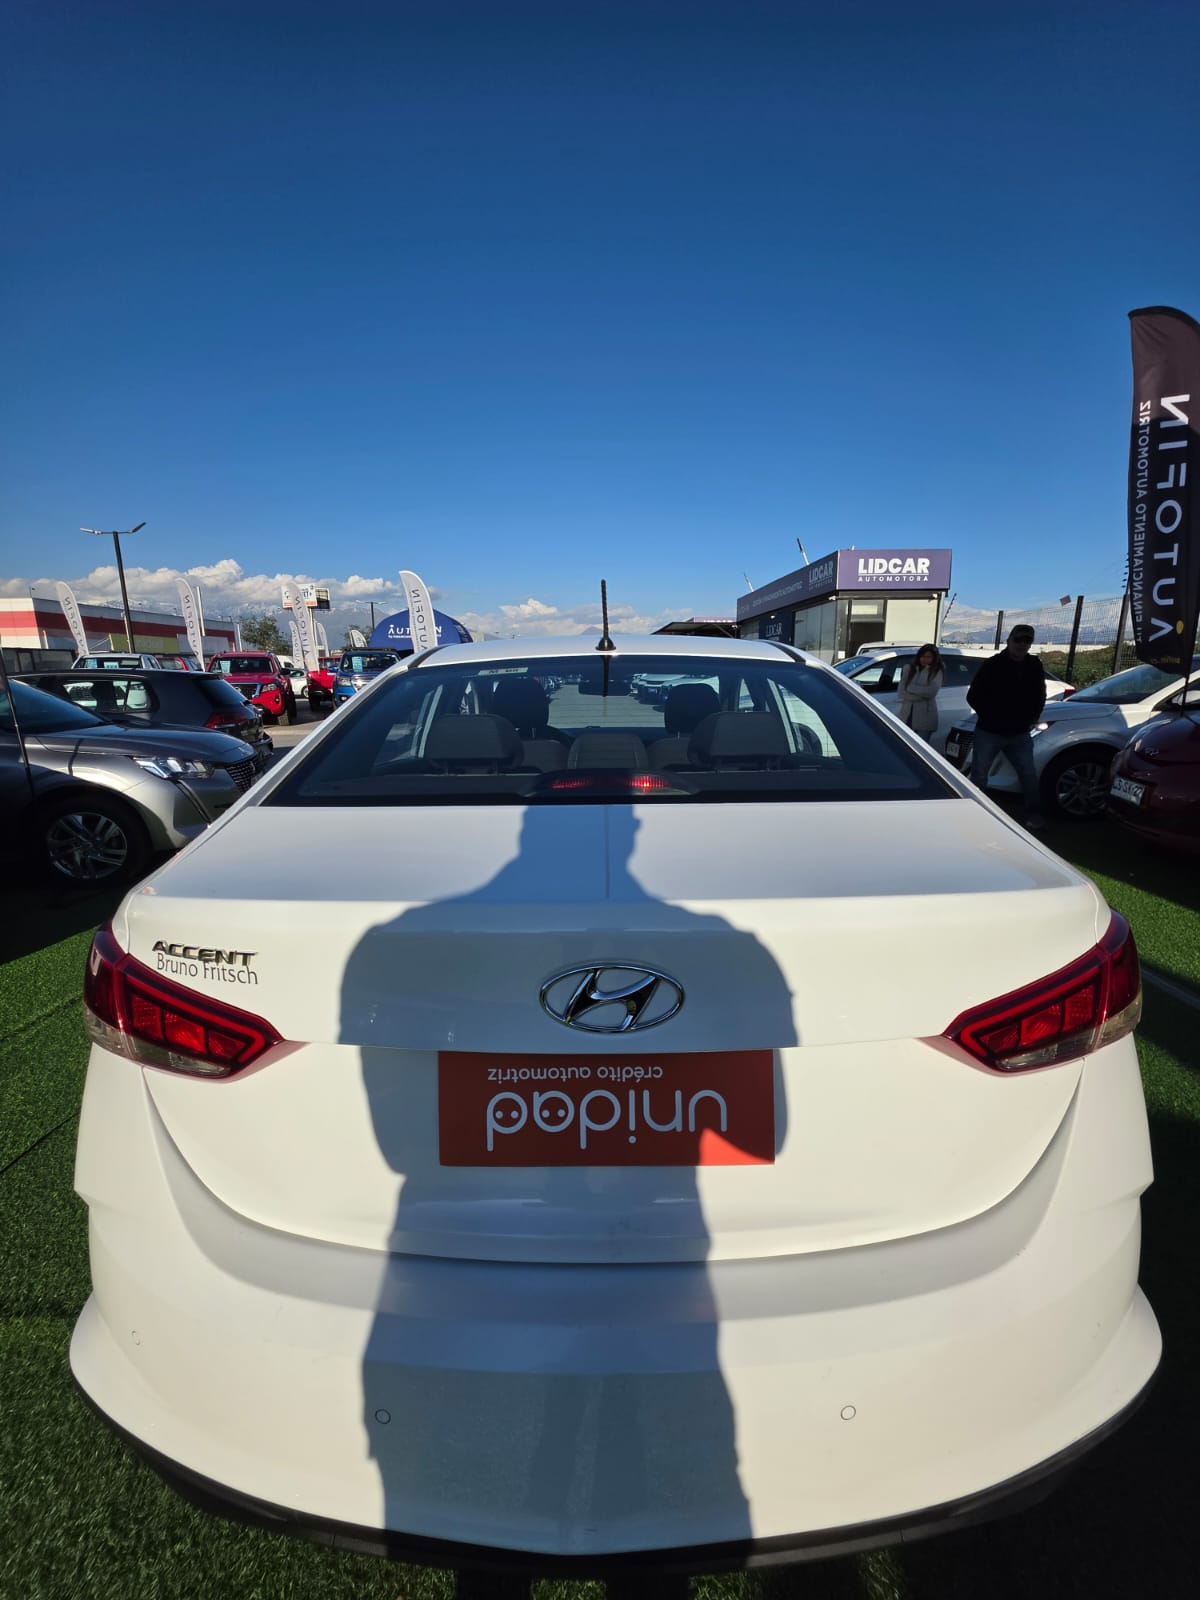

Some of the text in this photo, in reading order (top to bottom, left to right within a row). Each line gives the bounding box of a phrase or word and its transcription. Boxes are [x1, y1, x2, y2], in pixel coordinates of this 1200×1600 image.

[858, 557, 931, 574] LIDCAR
[858, 575, 930, 583] AUTOMOTORA
[152, 940, 259, 967] ACCENT
[157, 953, 258, 985] Bruno Fritsch
[488, 1065, 664, 1084] crédito automotriz
[486, 1089, 727, 1152] unidad
